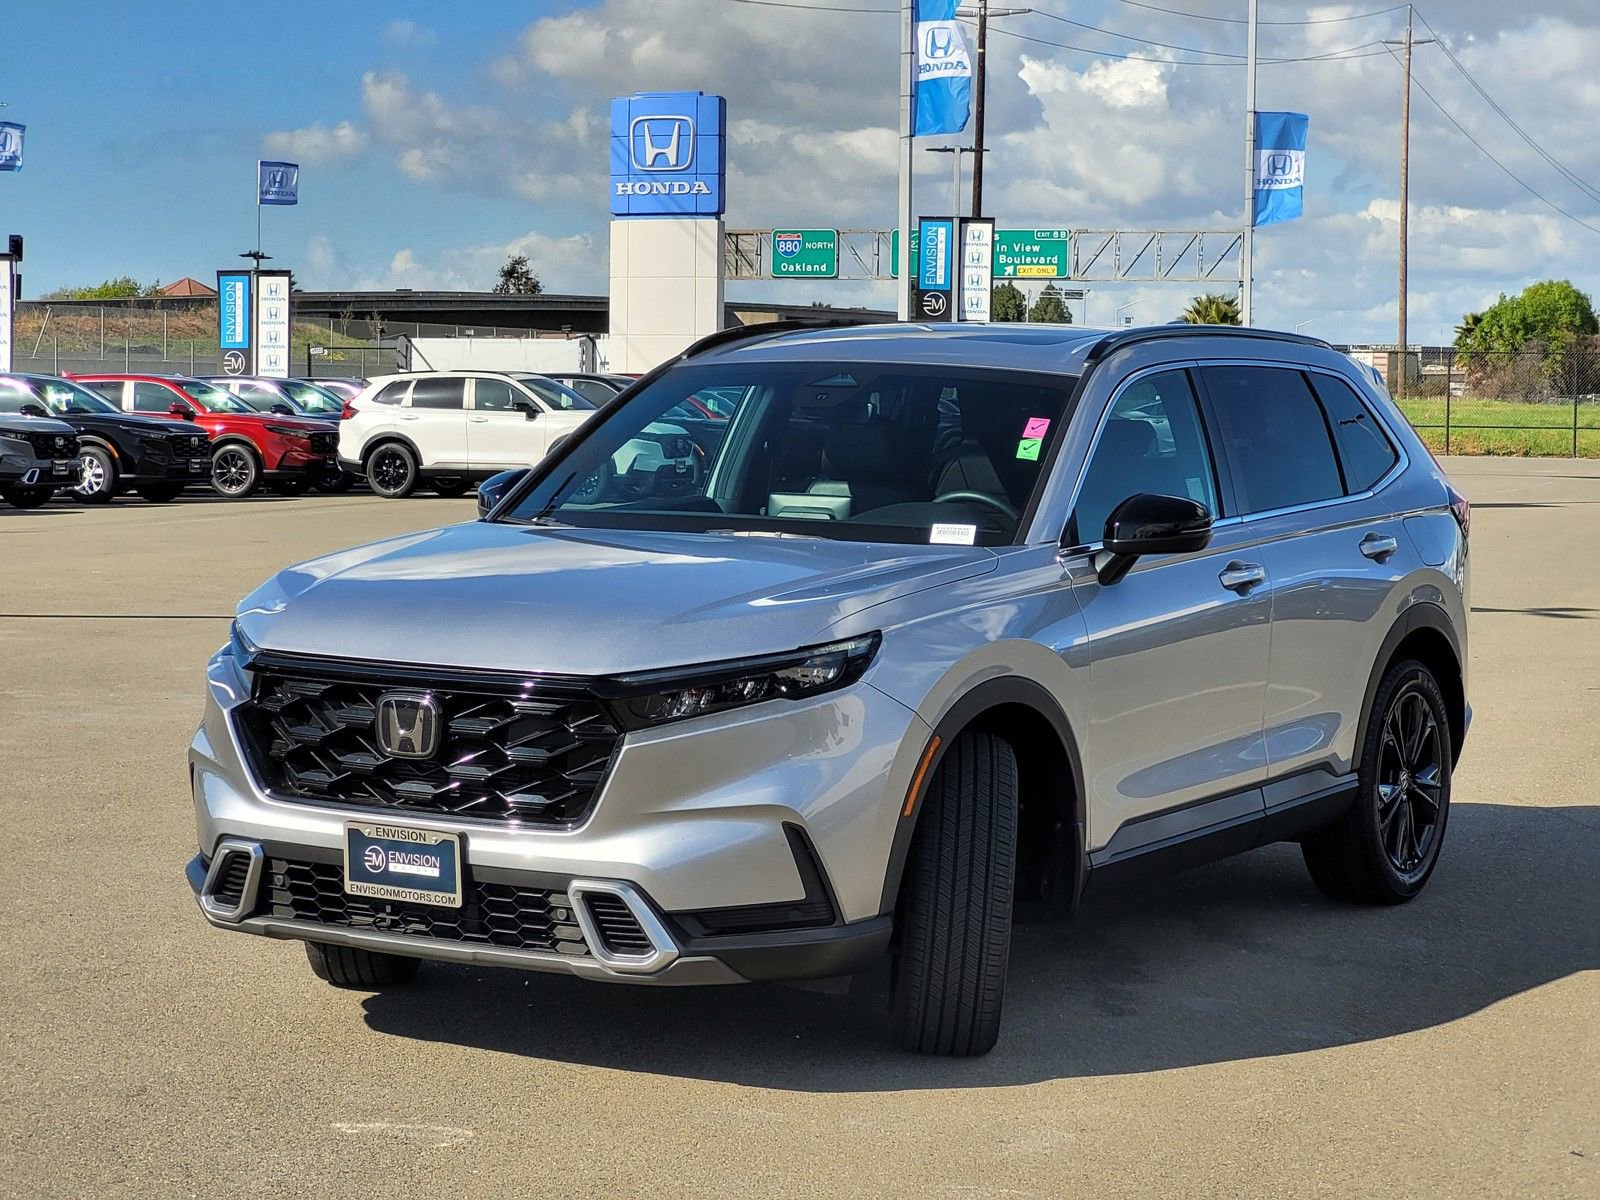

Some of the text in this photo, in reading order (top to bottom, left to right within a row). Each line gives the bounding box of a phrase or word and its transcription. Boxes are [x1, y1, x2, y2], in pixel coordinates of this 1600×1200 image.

[918, 61, 968, 74] HONDA
[615, 181, 711, 196] HONDA
[1257, 177, 1302, 186] HONDA
[779, 241, 800, 252] 880
[1013, 243, 1041, 253] View
[925, 226, 938, 285] ENVISION
[999, 255, 1058, 264] Boulevard
[781, 262, 827, 272] Oakland
[225, 281, 236, 343] ENVISION
[375, 827, 427, 842] ENVISION
[388, 851, 440, 868] ENVISION
[350, 884, 456, 905] ENVISIONMOTORS.COM
